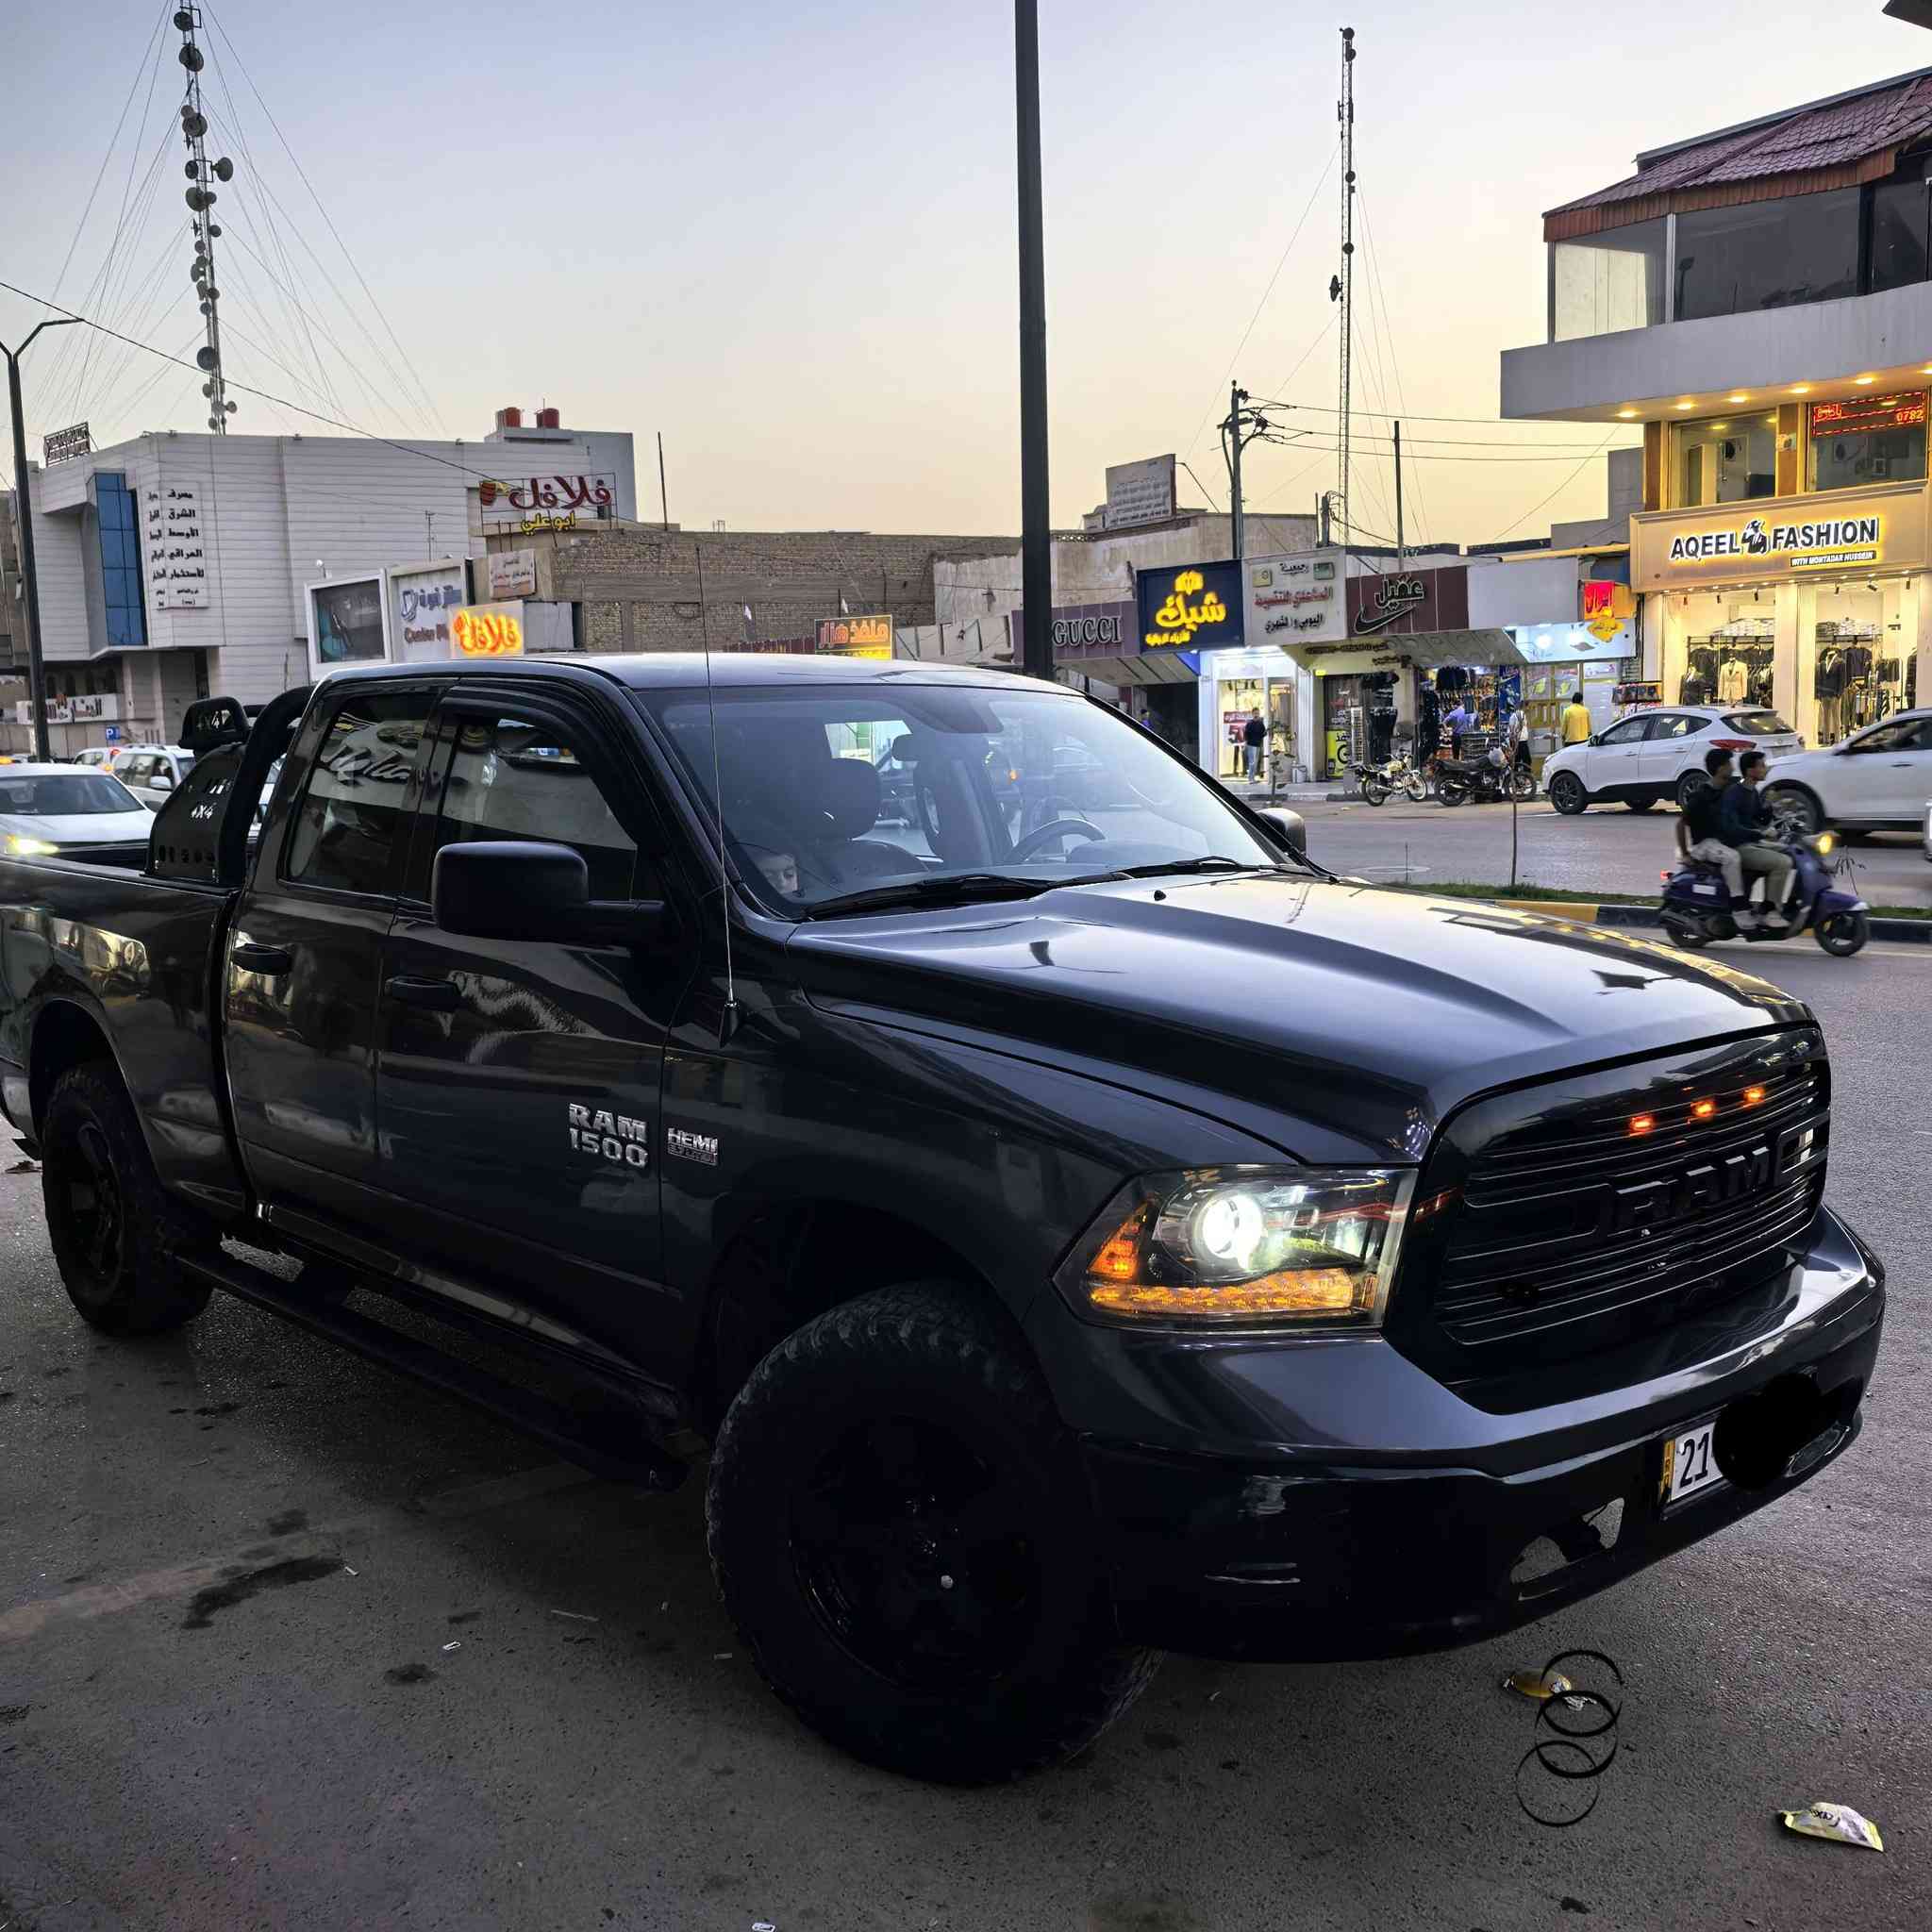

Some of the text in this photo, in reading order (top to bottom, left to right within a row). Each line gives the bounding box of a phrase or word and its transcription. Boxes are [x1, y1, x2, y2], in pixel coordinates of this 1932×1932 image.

[167, 489, 192, 500] مصرف
[508, 475, 611, 510] فلافل
[168, 508, 196, 521] الشرق
[520, 512, 552, 536] علي
[168, 548, 203, 560] العراقي
[1670, 518, 1879, 560] AQEEL FASHION
[1374, 572, 1425, 611] عقيل
[1052, 615, 1121, 647] GUCCI
[569, 1103, 648, 1143] RAM
[668, 1127, 718, 1153] HEMI
[569, 1127, 649, 1169] 1500
[1615, 1145, 1771, 1232] RAM
[1679, 1432, 1709, 1489] 21
